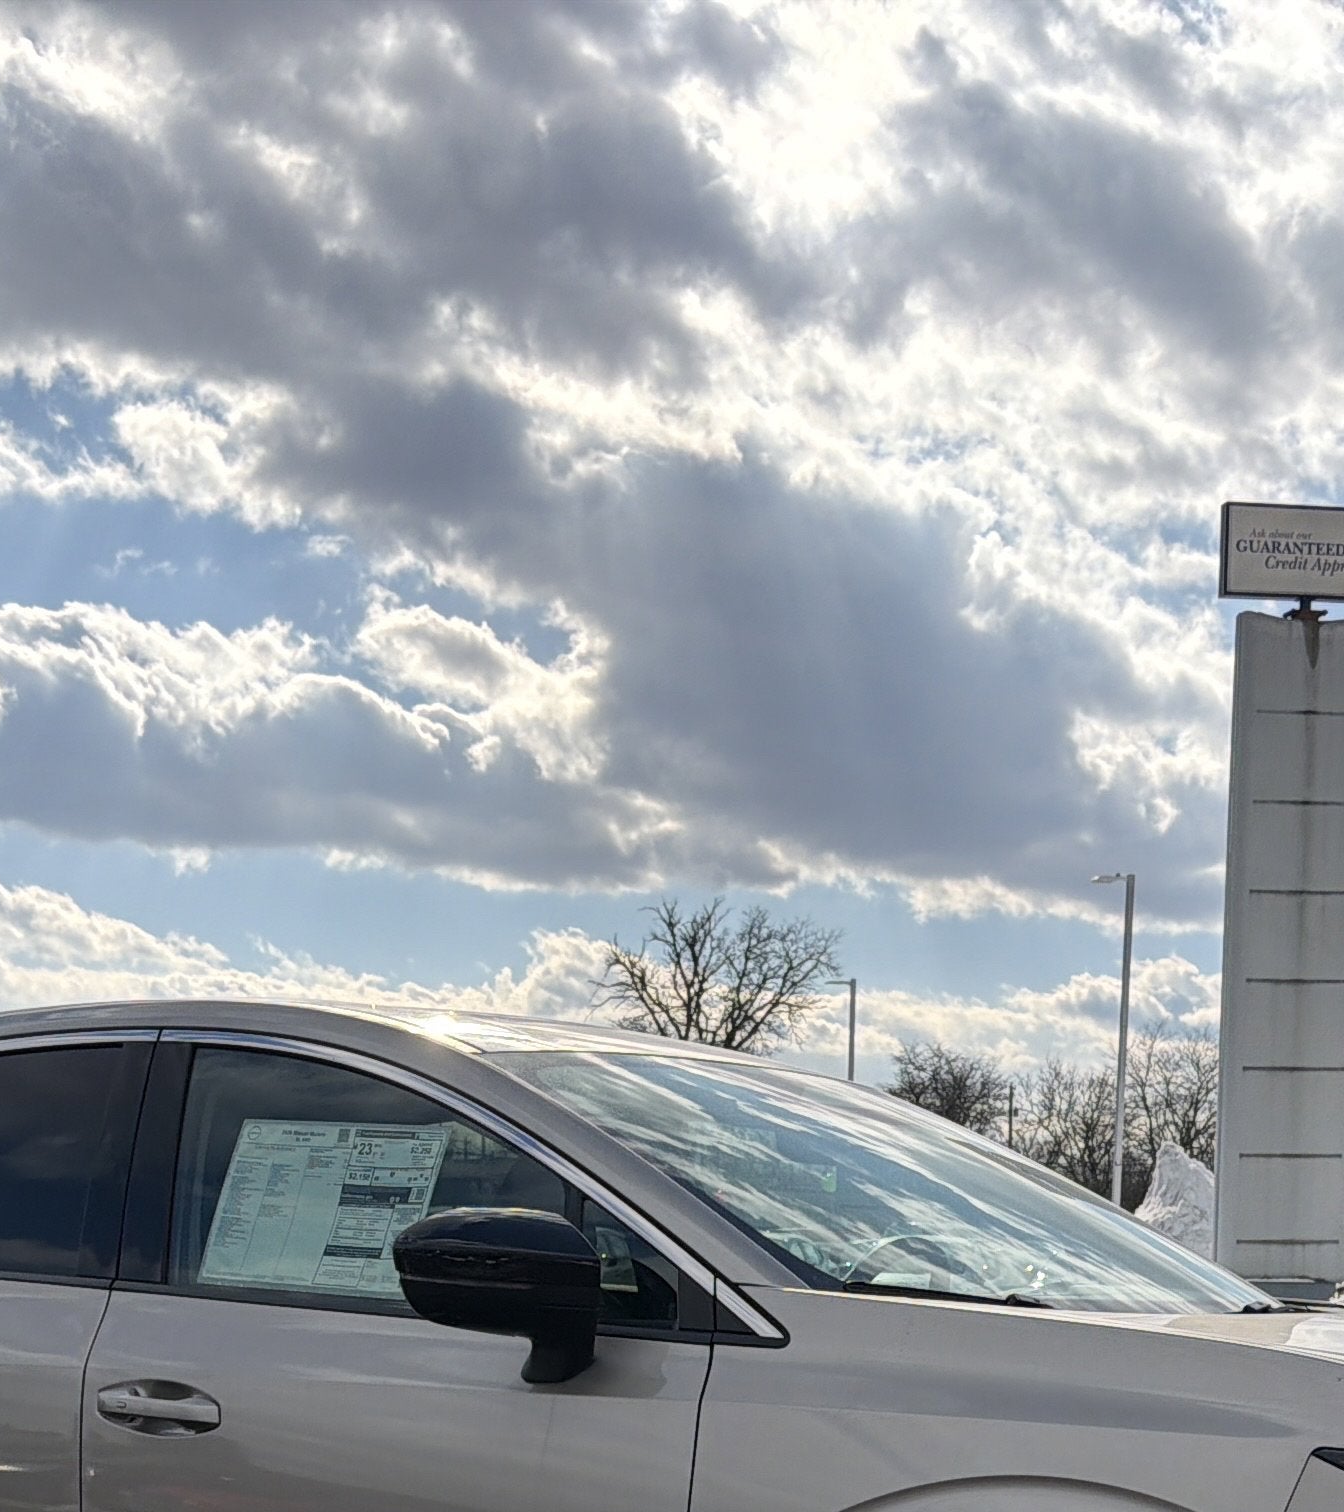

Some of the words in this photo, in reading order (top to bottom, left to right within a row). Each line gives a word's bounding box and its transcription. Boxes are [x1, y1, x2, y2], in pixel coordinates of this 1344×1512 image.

[1249, 528, 1266, 538] Ask
[1269, 529, 1294, 539] about
[1264, 555, 1308, 571] Credit
[358, 1142, 373, 1155] 23
